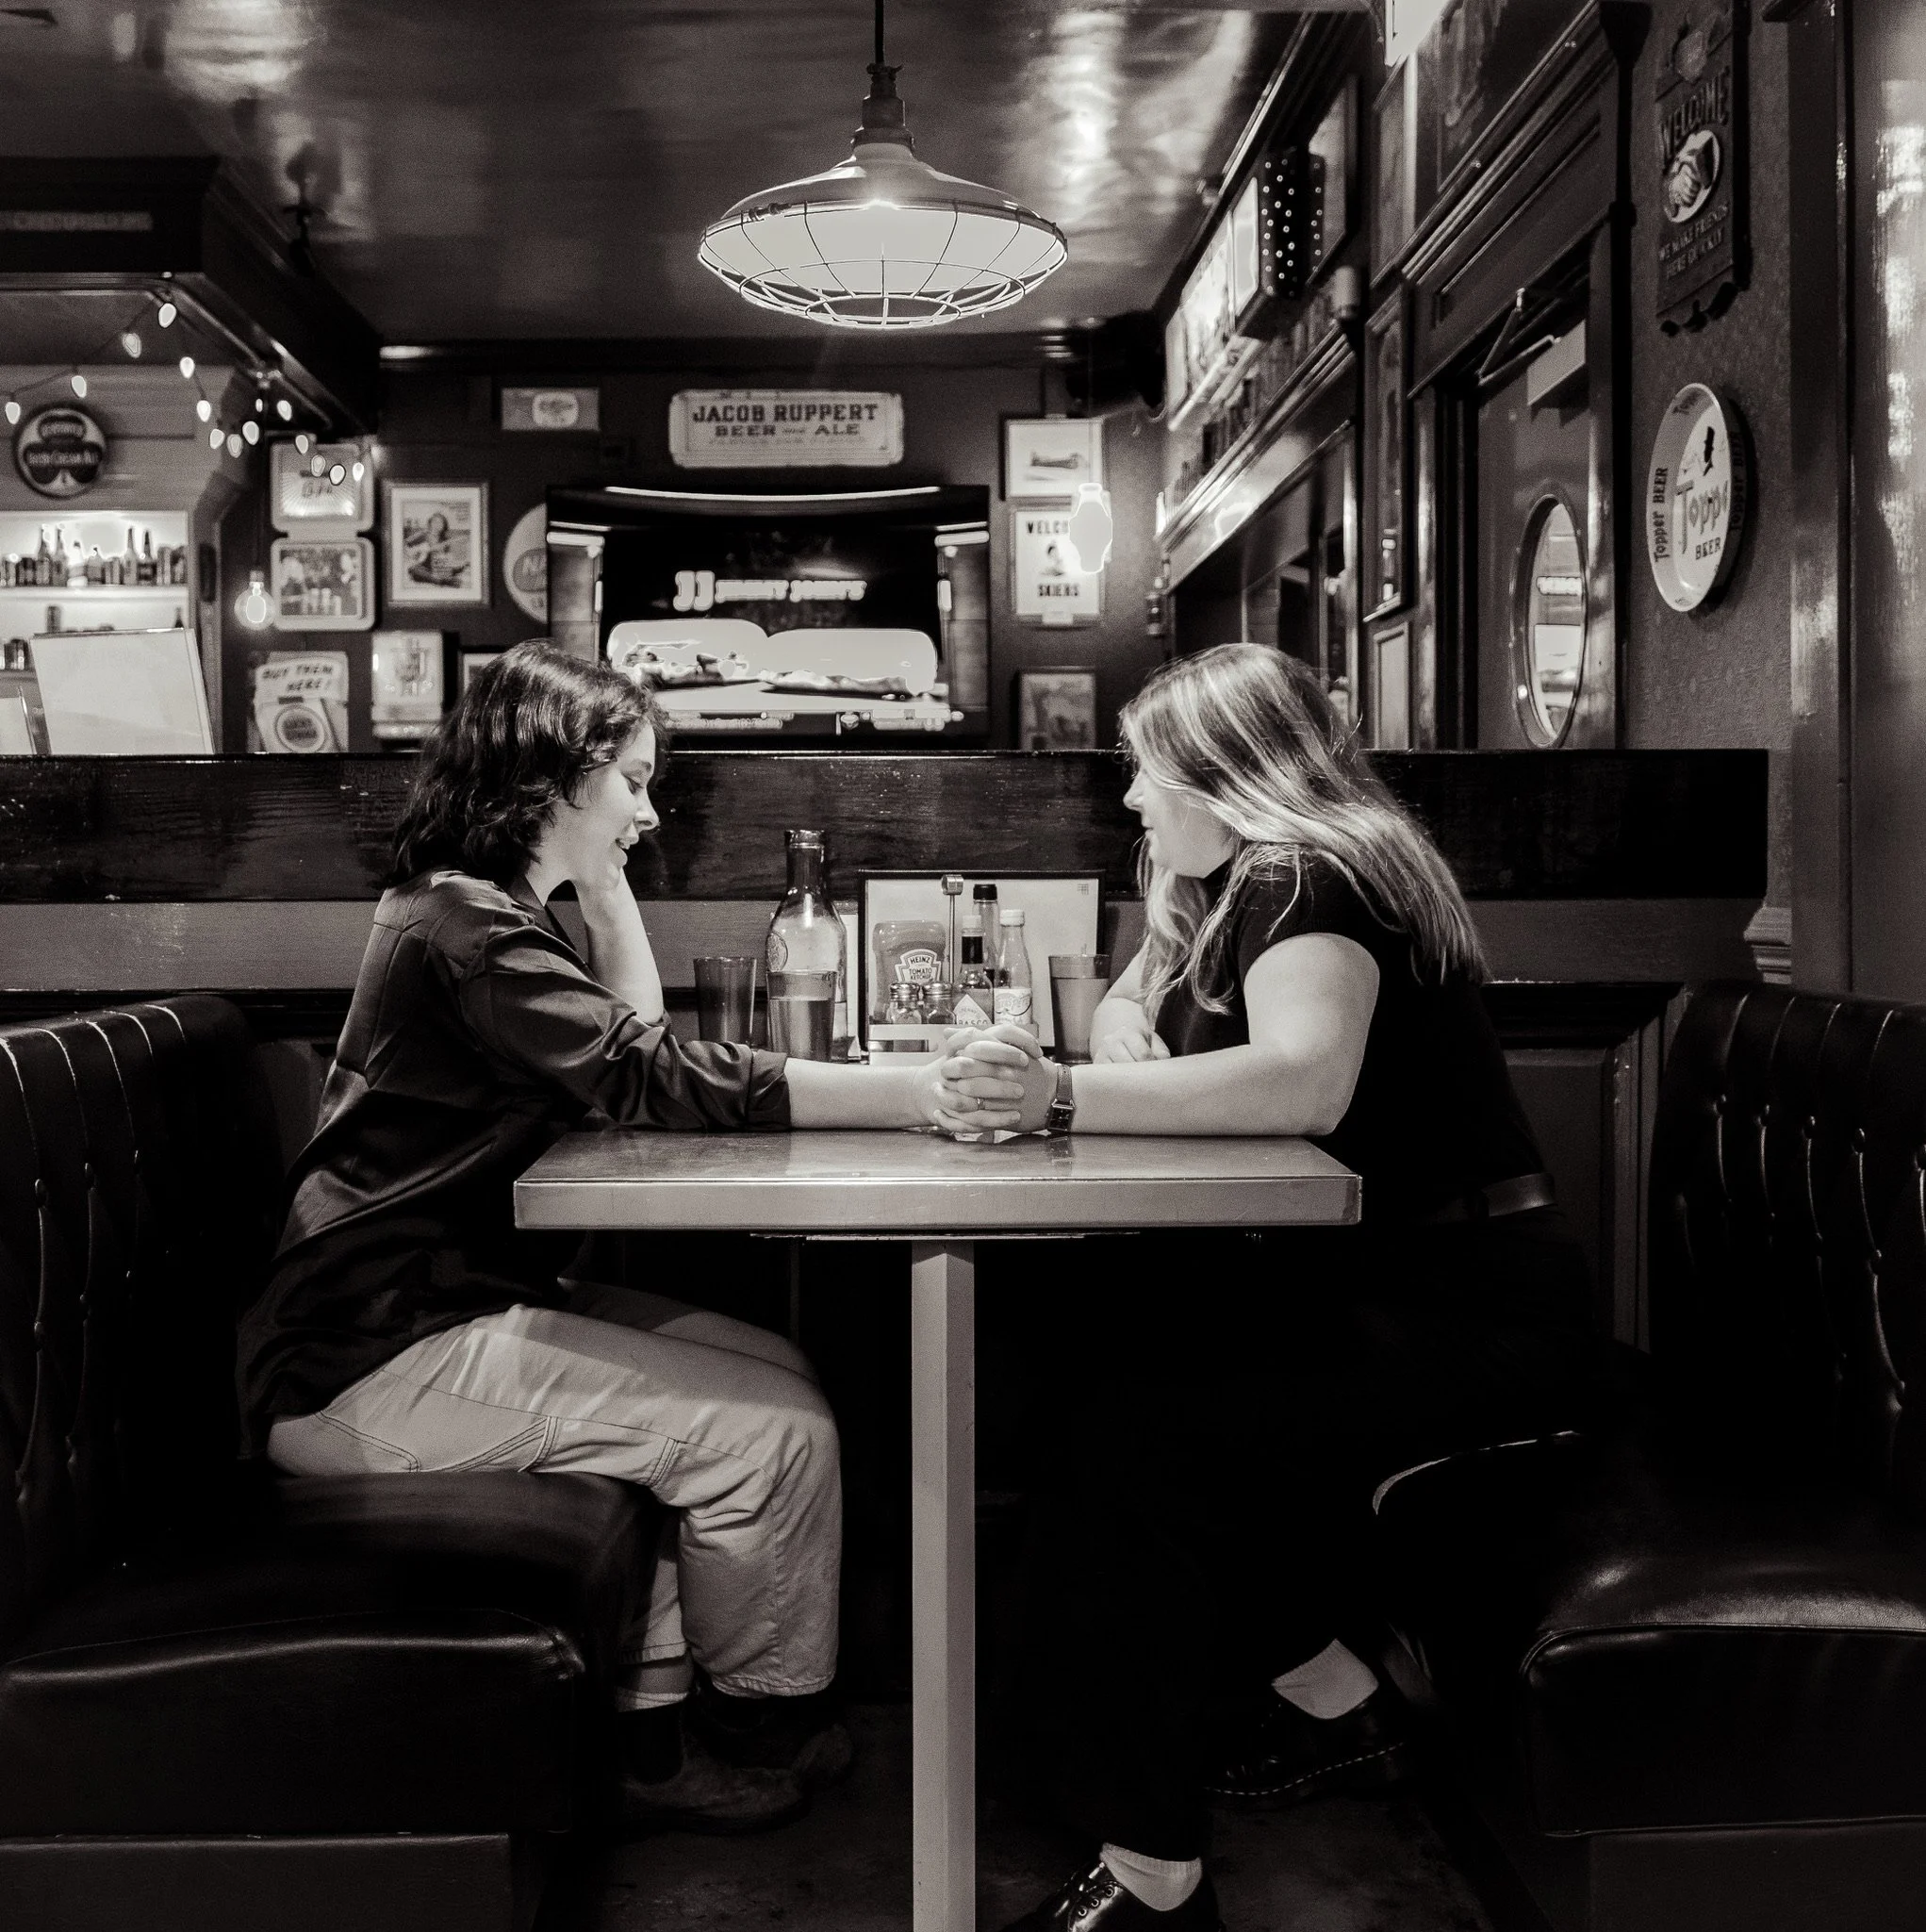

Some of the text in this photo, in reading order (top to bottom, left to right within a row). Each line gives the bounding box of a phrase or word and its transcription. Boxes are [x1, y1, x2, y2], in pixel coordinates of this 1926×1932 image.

[1660, 68, 1729, 166] WELCOME
[693, 404, 879, 422] JACOB RUPPERT
[715, 425, 777, 437] BEER
[815, 424, 860, 436] ALE
[1653, 468, 1671, 562] Topper BEER
[1696, 537, 1720, 560] BEER
[1039, 584, 1078, 596] SKIERS
[297, 665, 332, 675] THEM
[910, 955, 930, 964] HEINZ
